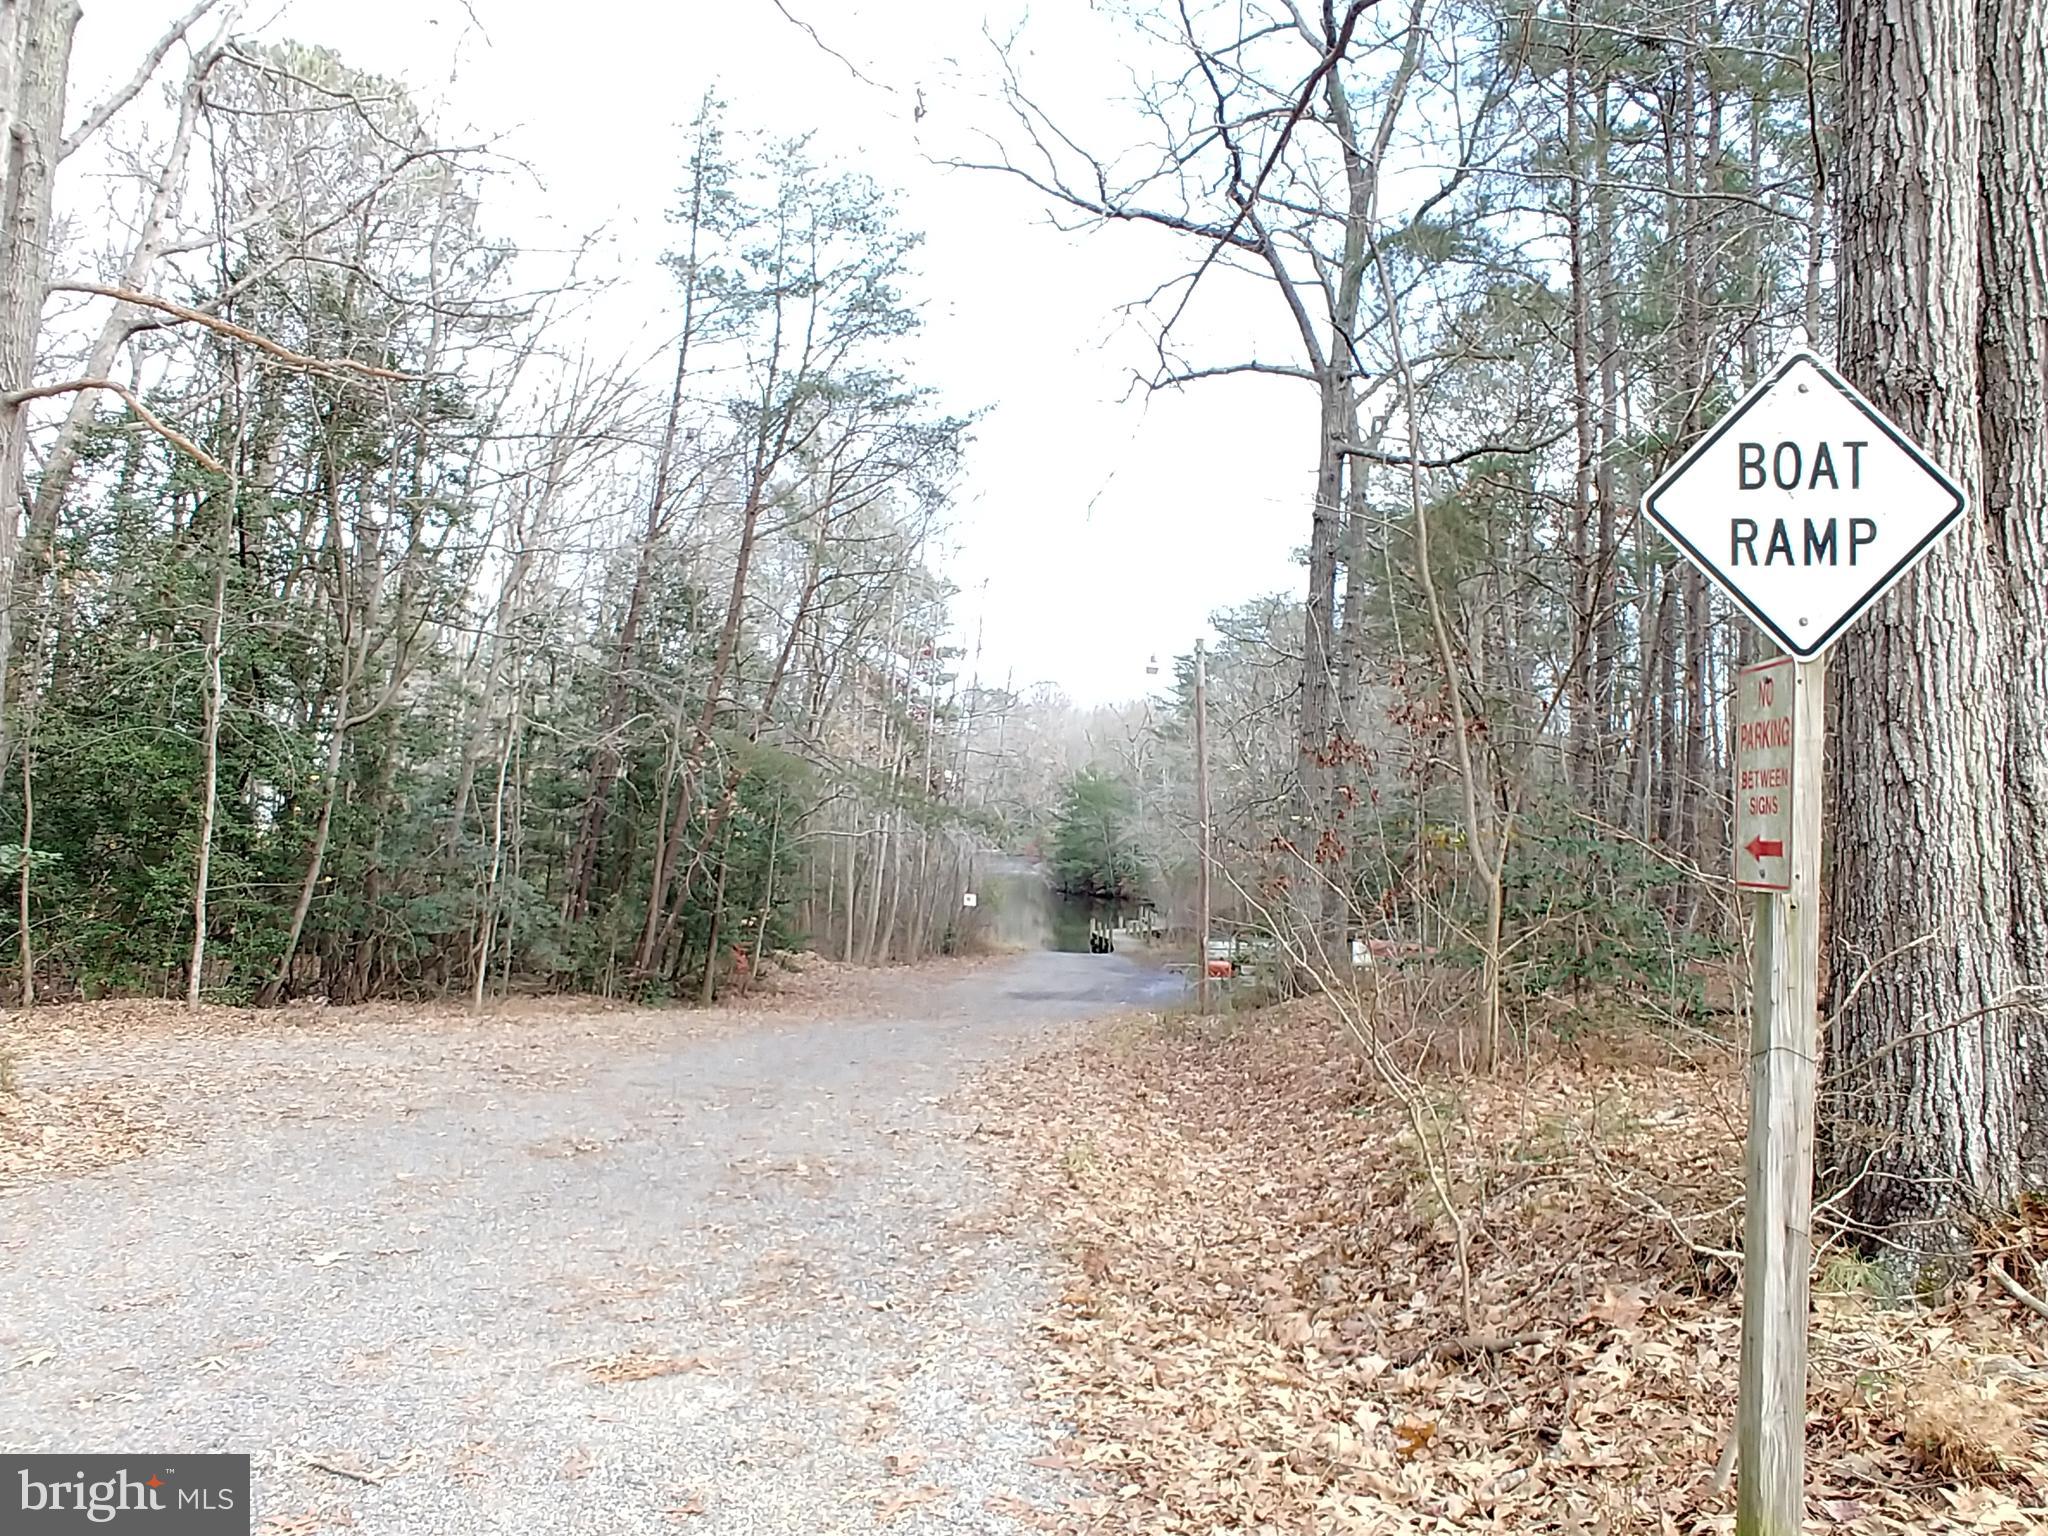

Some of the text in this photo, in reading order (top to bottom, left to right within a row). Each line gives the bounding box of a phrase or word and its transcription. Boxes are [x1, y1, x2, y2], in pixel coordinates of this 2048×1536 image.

[1738, 441, 1868, 490] BOAT
[1731, 518, 1877, 566] RAMP
[1759, 677, 1774, 707] NO
[1741, 717, 1790, 751] PARKING
[1741, 769, 1788, 790] BETWEEN
[1749, 795, 1779, 816] SIGNS
